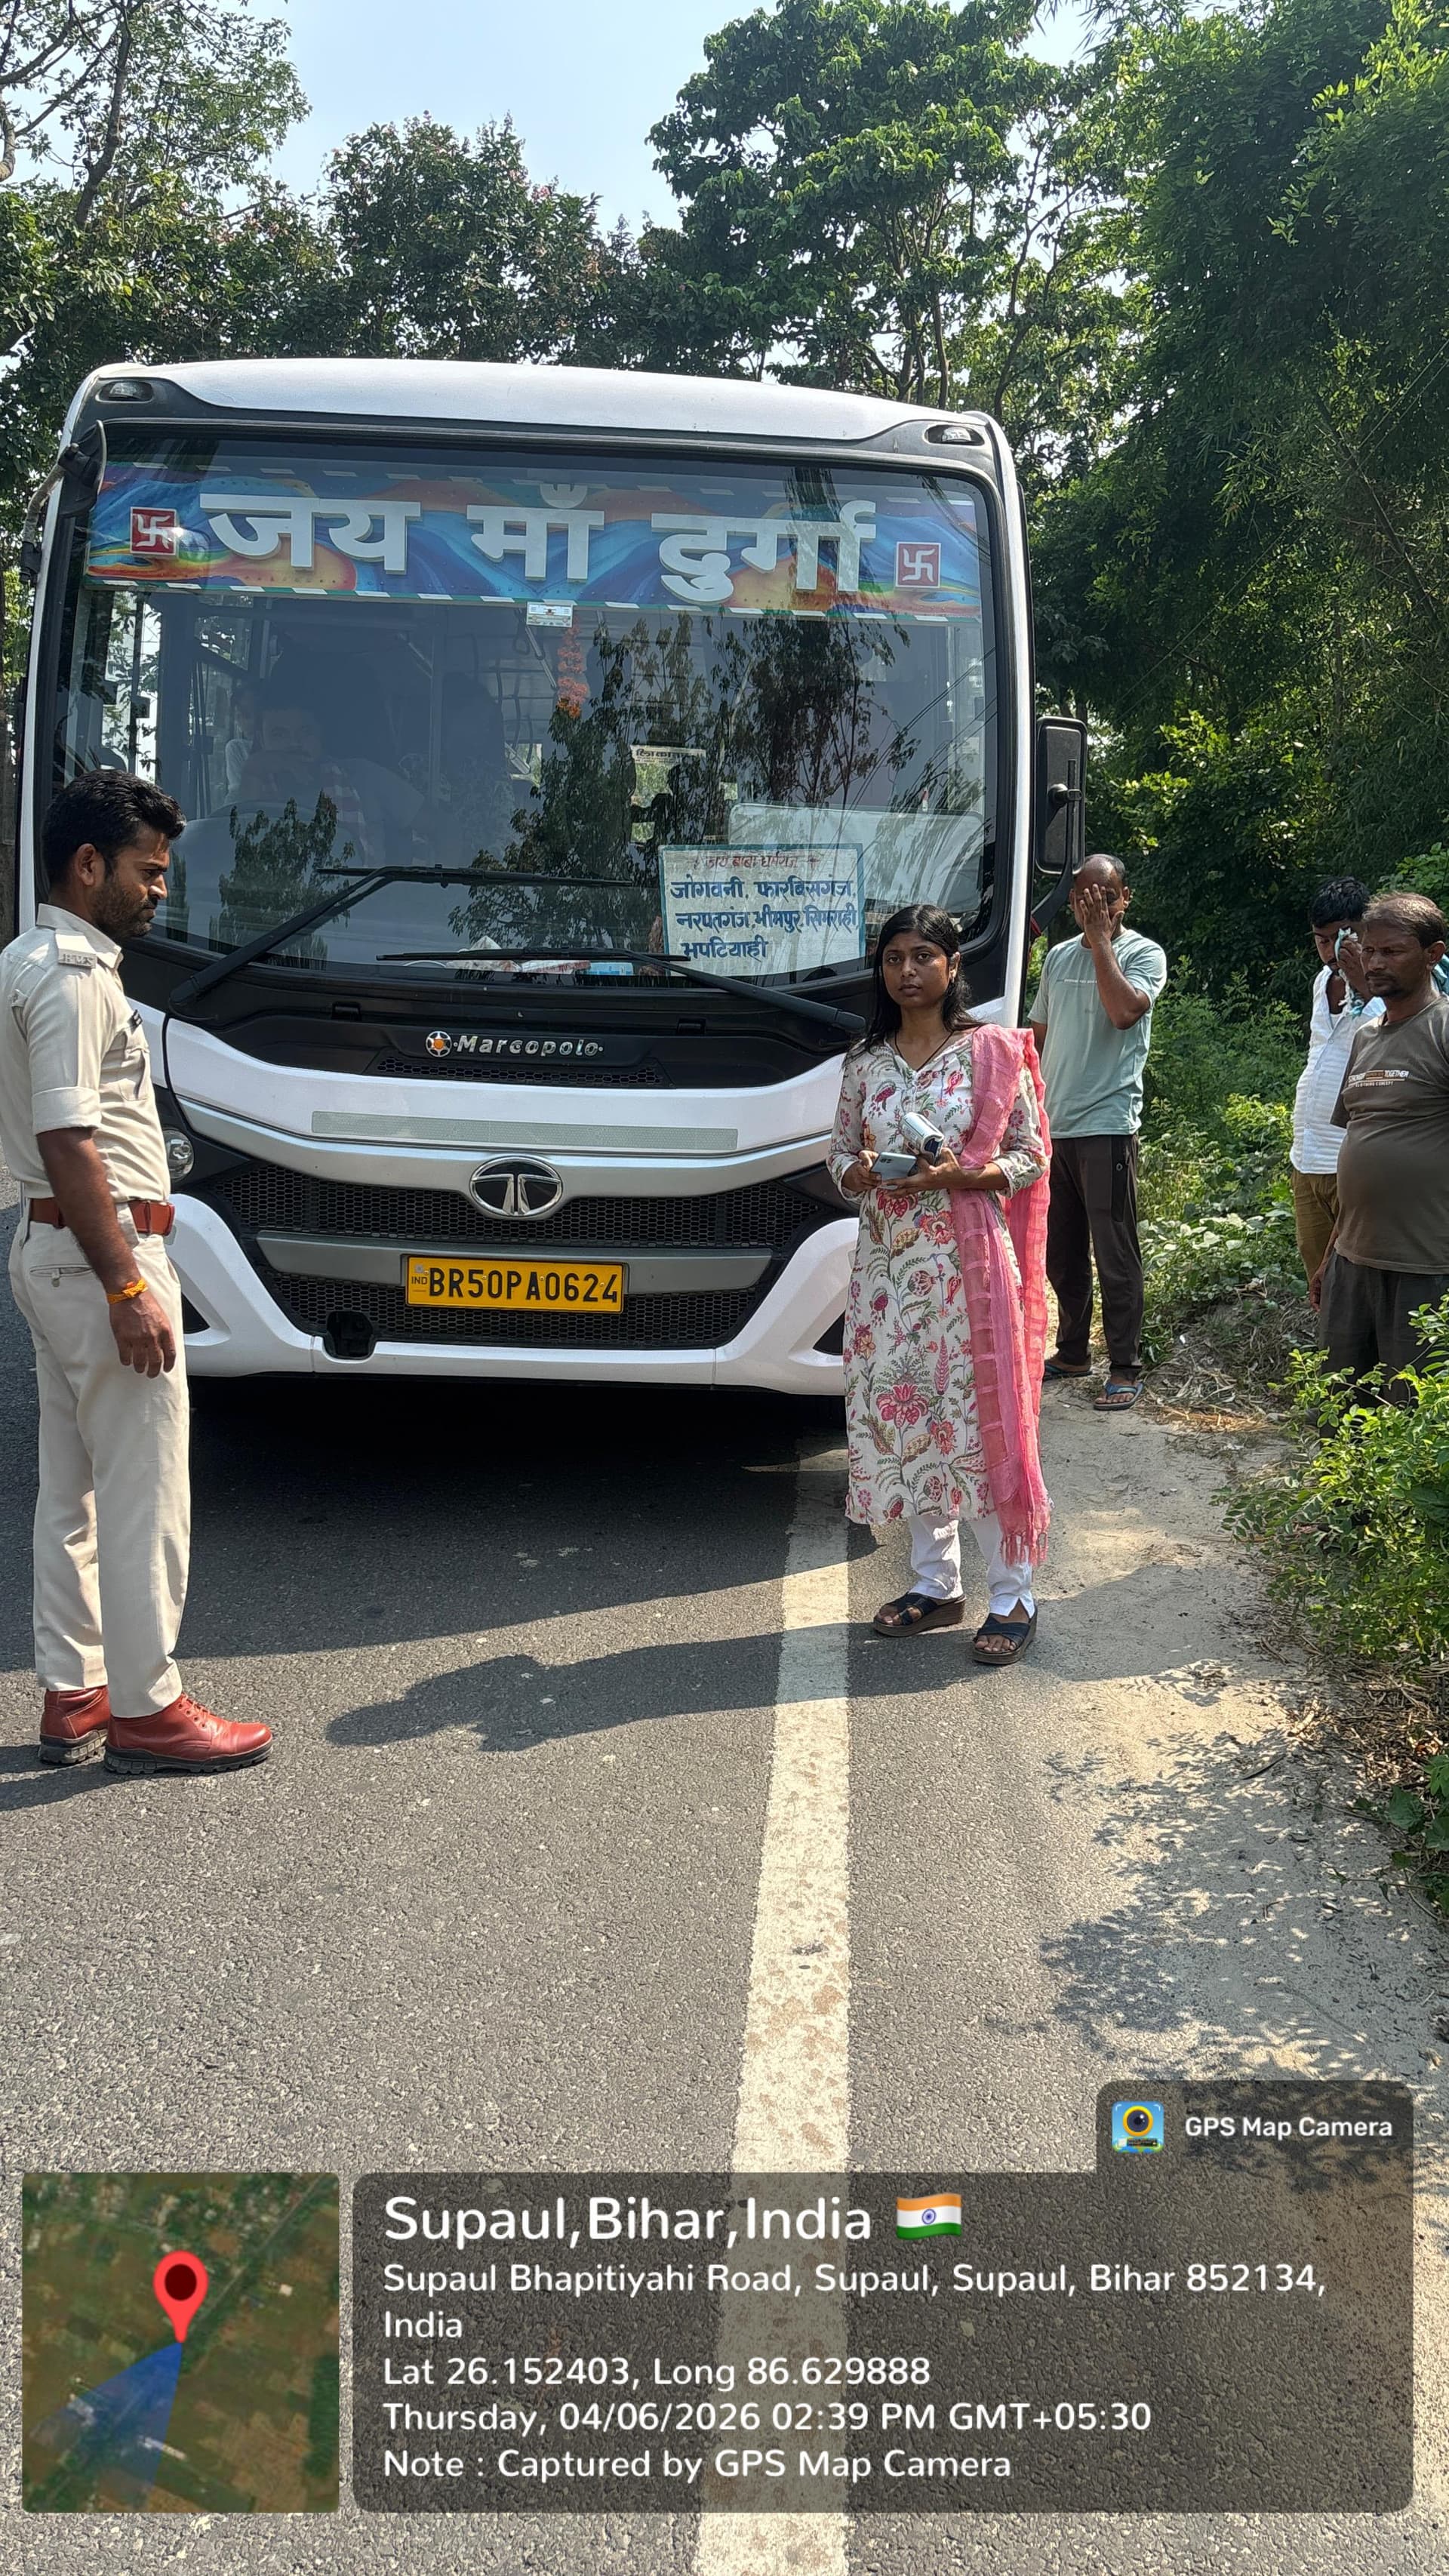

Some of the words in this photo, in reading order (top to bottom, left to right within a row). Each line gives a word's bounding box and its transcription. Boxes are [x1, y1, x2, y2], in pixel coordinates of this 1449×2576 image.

[200, 494, 423, 576] जय
[466, 483, 605, 583] माँ
[651, 500, 877, 604] दुर्गा
[457, 1035, 598, 1057] Marcopolo
[411, 1276, 428, 1285] IND
[429, 1267, 618, 1303] BR50PA0624
